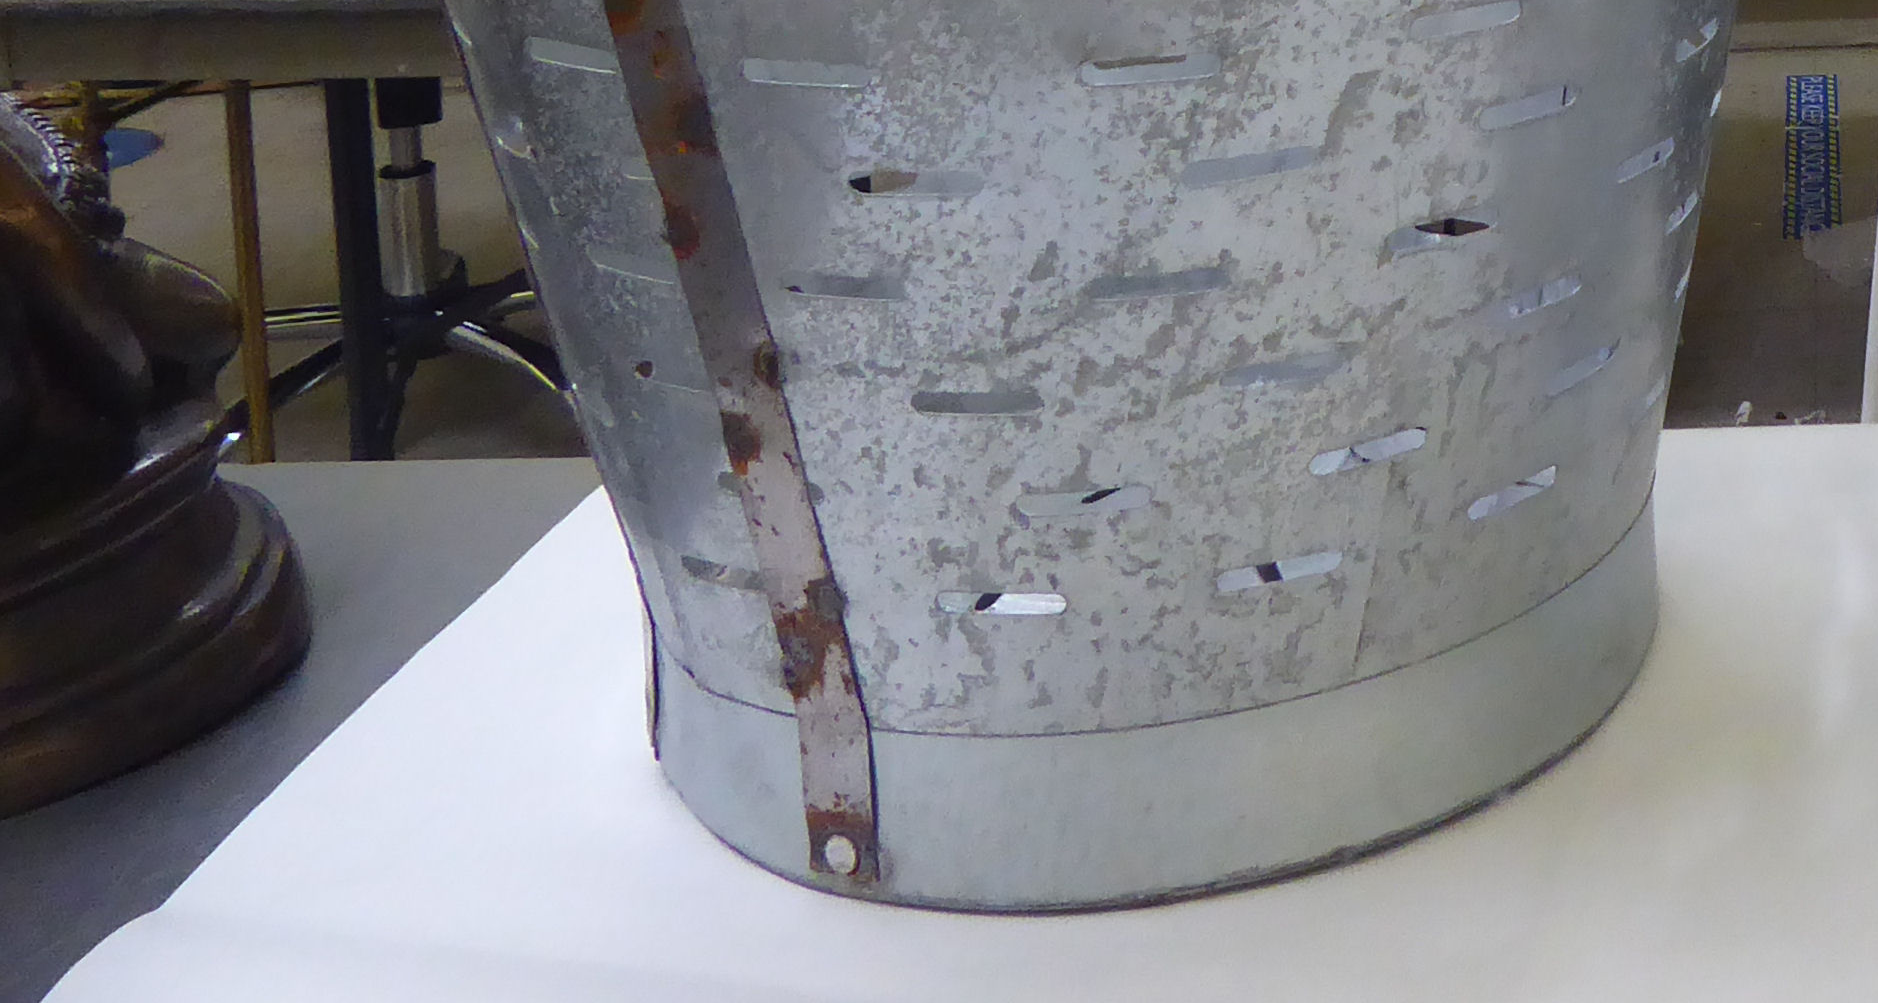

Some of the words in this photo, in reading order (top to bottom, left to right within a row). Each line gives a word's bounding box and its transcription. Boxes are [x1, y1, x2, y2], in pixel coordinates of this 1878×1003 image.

[1801, 76, 1824, 103] PLEASE
[1801, 105, 1824, 125] KEEP
[1801, 126, 1825, 152] YOUR
[1801, 154, 1825, 186] SOCIAL
